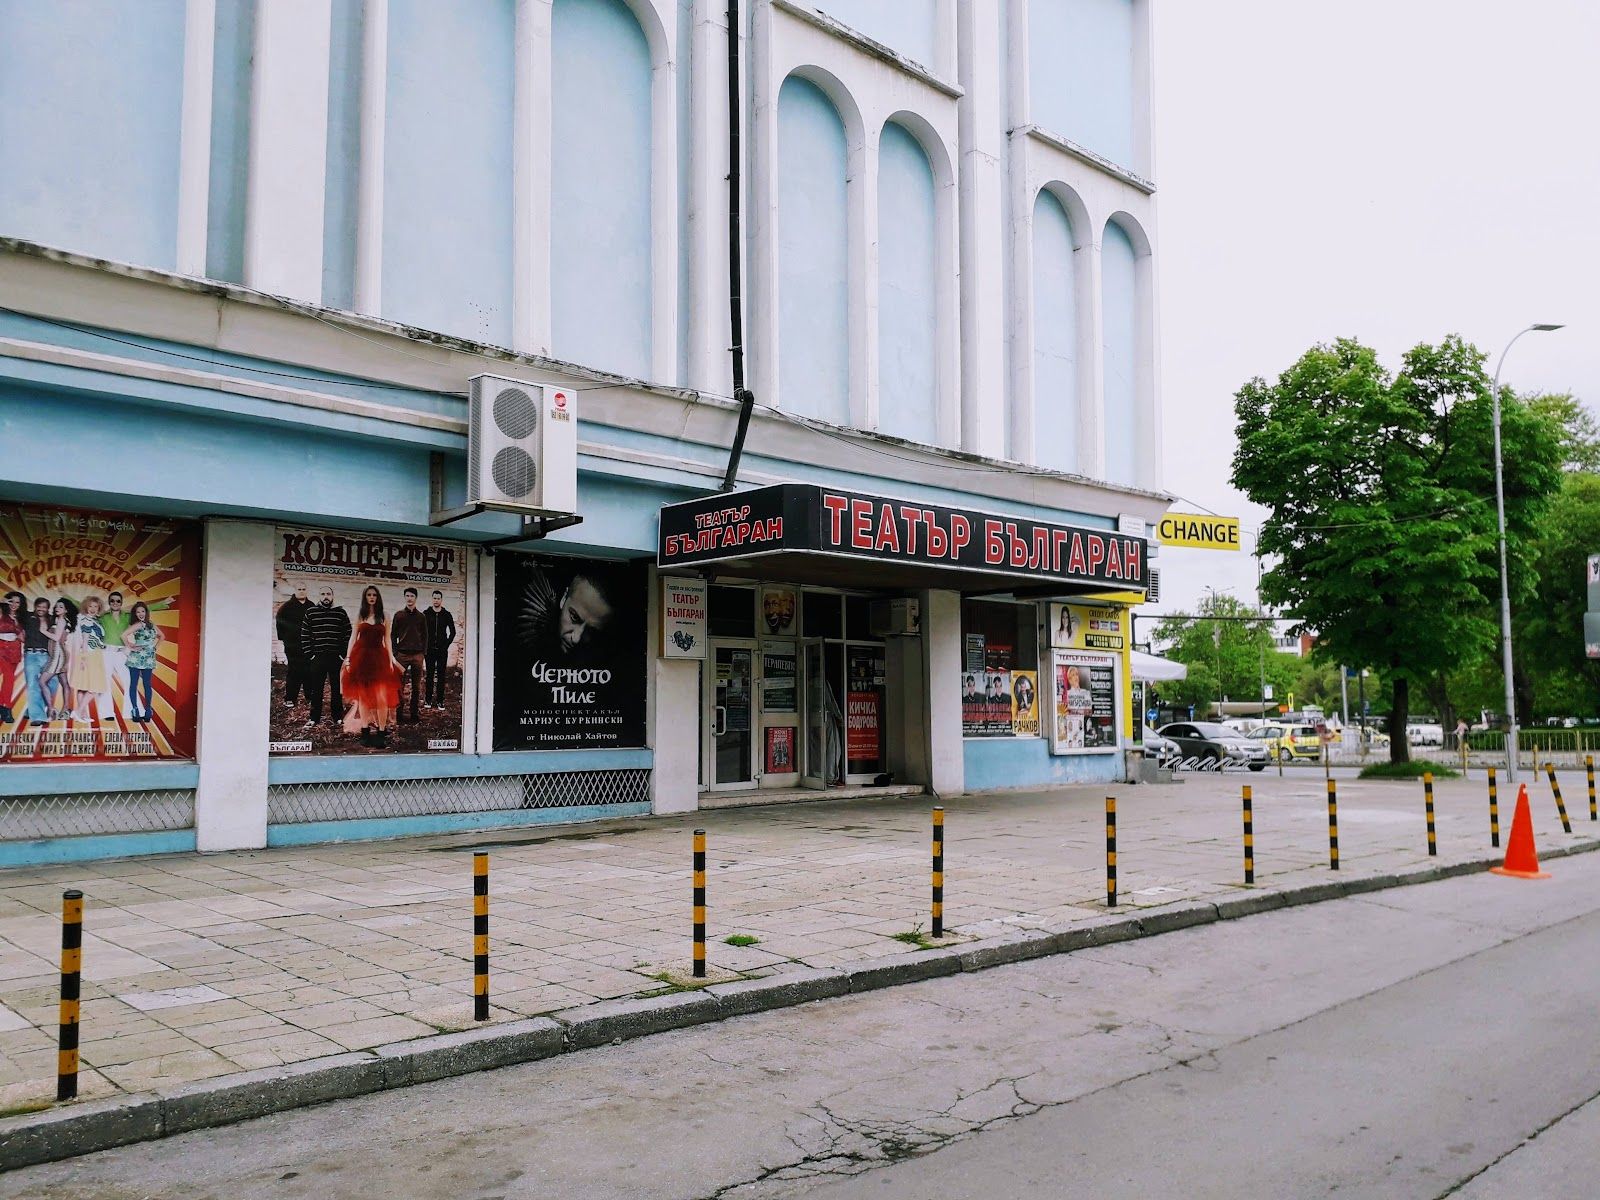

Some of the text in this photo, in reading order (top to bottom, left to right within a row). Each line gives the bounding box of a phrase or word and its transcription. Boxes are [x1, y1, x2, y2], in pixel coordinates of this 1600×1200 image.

[695, 505, 751, 529] ТЕАТЪР
[665, 517, 783, 556] БЪЛГАРАН
[824, 494, 1141, 581] ТЕАТЪР БЪЛГАРАН
[1160, 519, 1238, 544] CHANGE
[29, 536, 132, 563] Когато
[281, 533, 455, 576] КОНЦЕРТЪТ
[7, 554, 149, 597] Котката
[62, 572, 115, 591] няма
[672, 593, 700, 605] ТЕАТЪР
[667, 607, 705, 620] БЪЛГАРАН
[849, 701, 877, 715] КИЧКА
[519, 716, 623, 725] МАРИУС КУРКИНСКИ
[848, 715, 878, 731] БОДУРОВА
[1014, 720, 1038, 732] РАЧКОВ
[104, 732, 123, 743] ЕЛЕНА
[540, 732, 582, 741] Николай
[585, 732, 618, 740] Хайтов
[270, 743, 311, 751] БЪЛГАРАН
